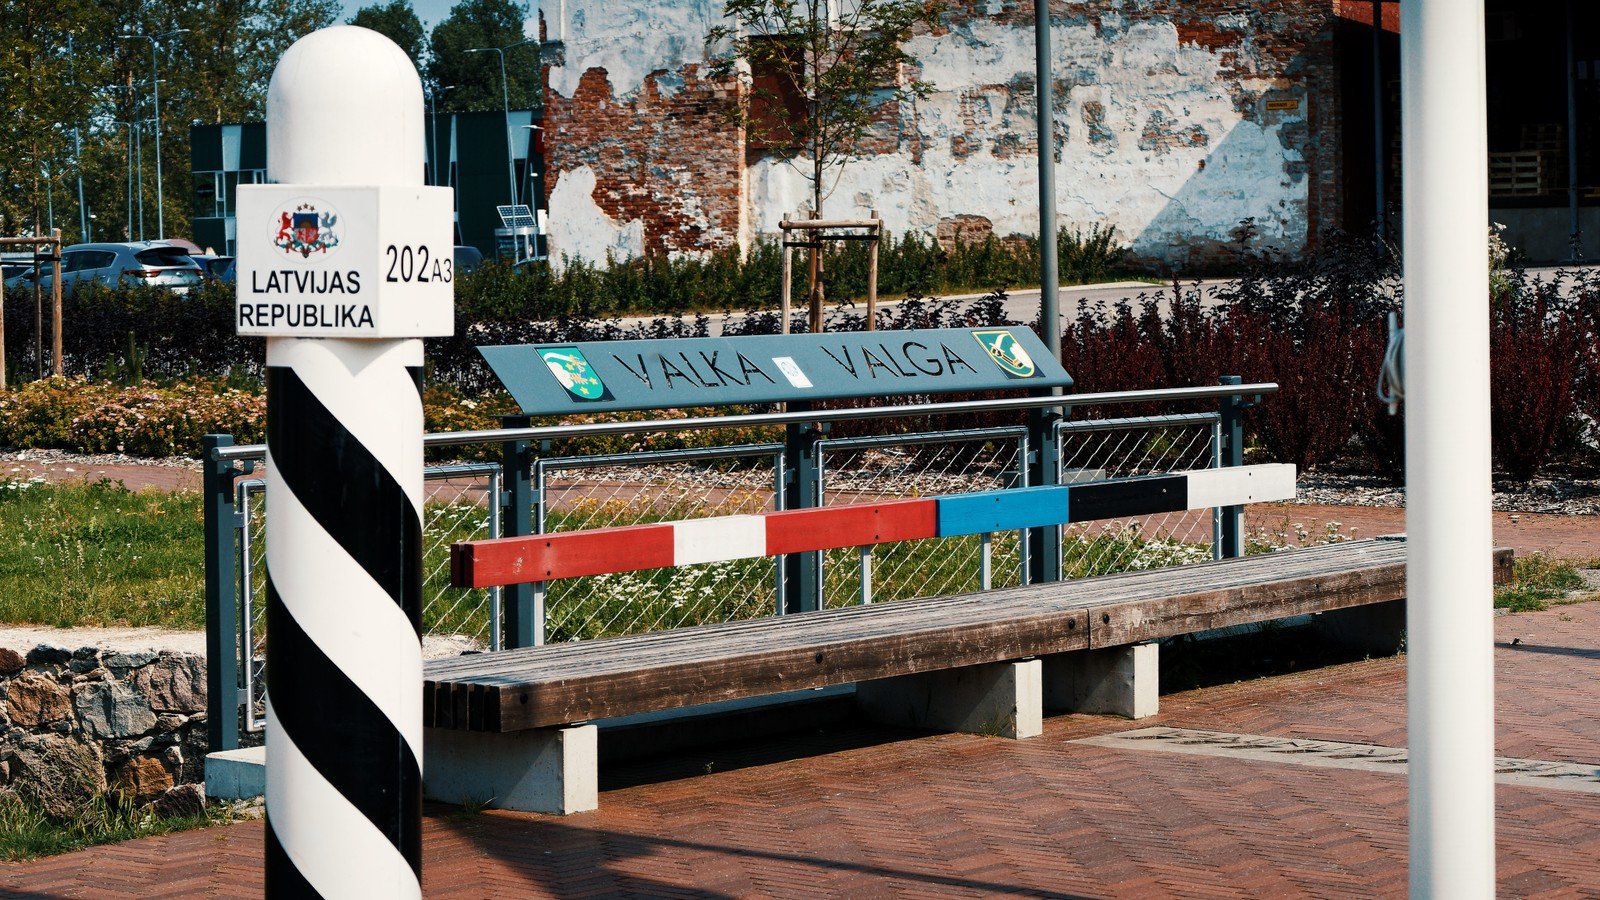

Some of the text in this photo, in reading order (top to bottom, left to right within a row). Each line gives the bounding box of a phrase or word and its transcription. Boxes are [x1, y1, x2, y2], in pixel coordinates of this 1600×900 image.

[252, 270, 361, 295] LATVIJAS
[239, 303, 375, 328] REPUBLIKA
[612, 341, 978, 391] VALKA VALGA
